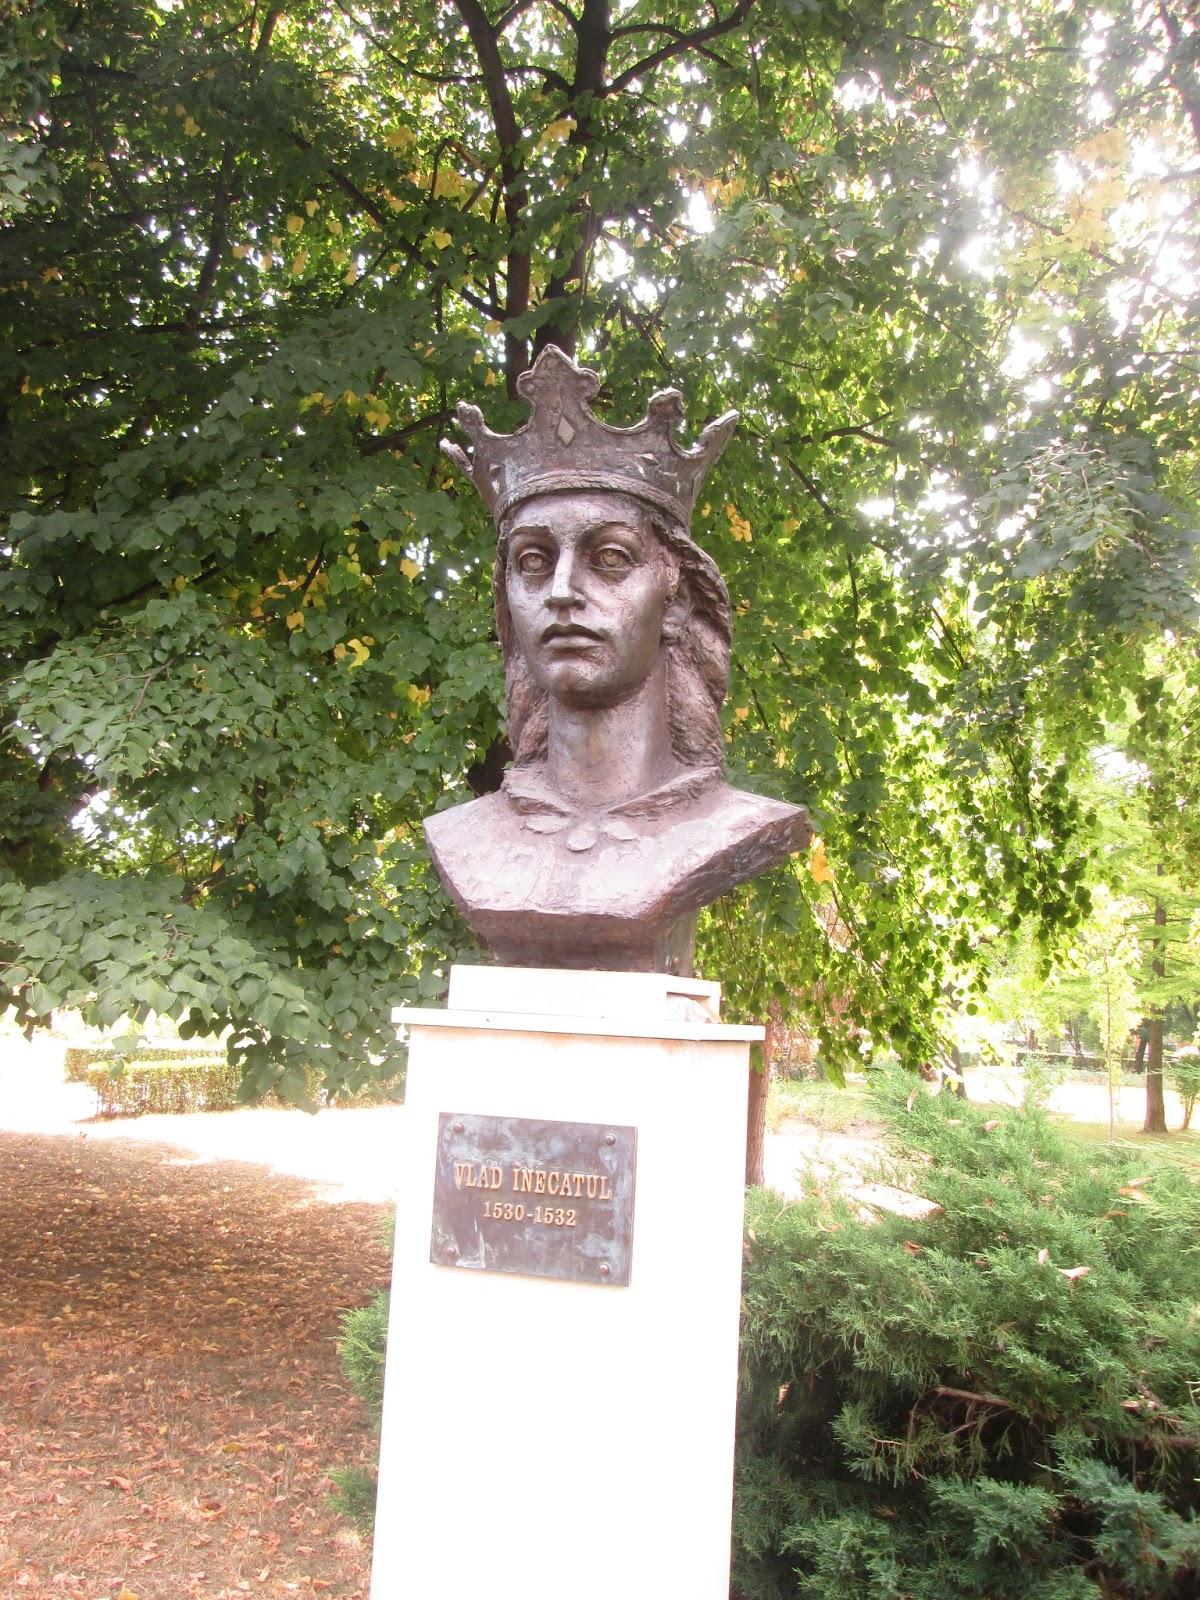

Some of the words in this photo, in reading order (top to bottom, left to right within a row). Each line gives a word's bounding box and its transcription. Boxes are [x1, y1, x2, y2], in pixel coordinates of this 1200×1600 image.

[453, 1163, 503, 1190] VLAD
[512, 1168, 612, 1200] INECATUL
[483, 1201, 577, 1227] 1530-1532
